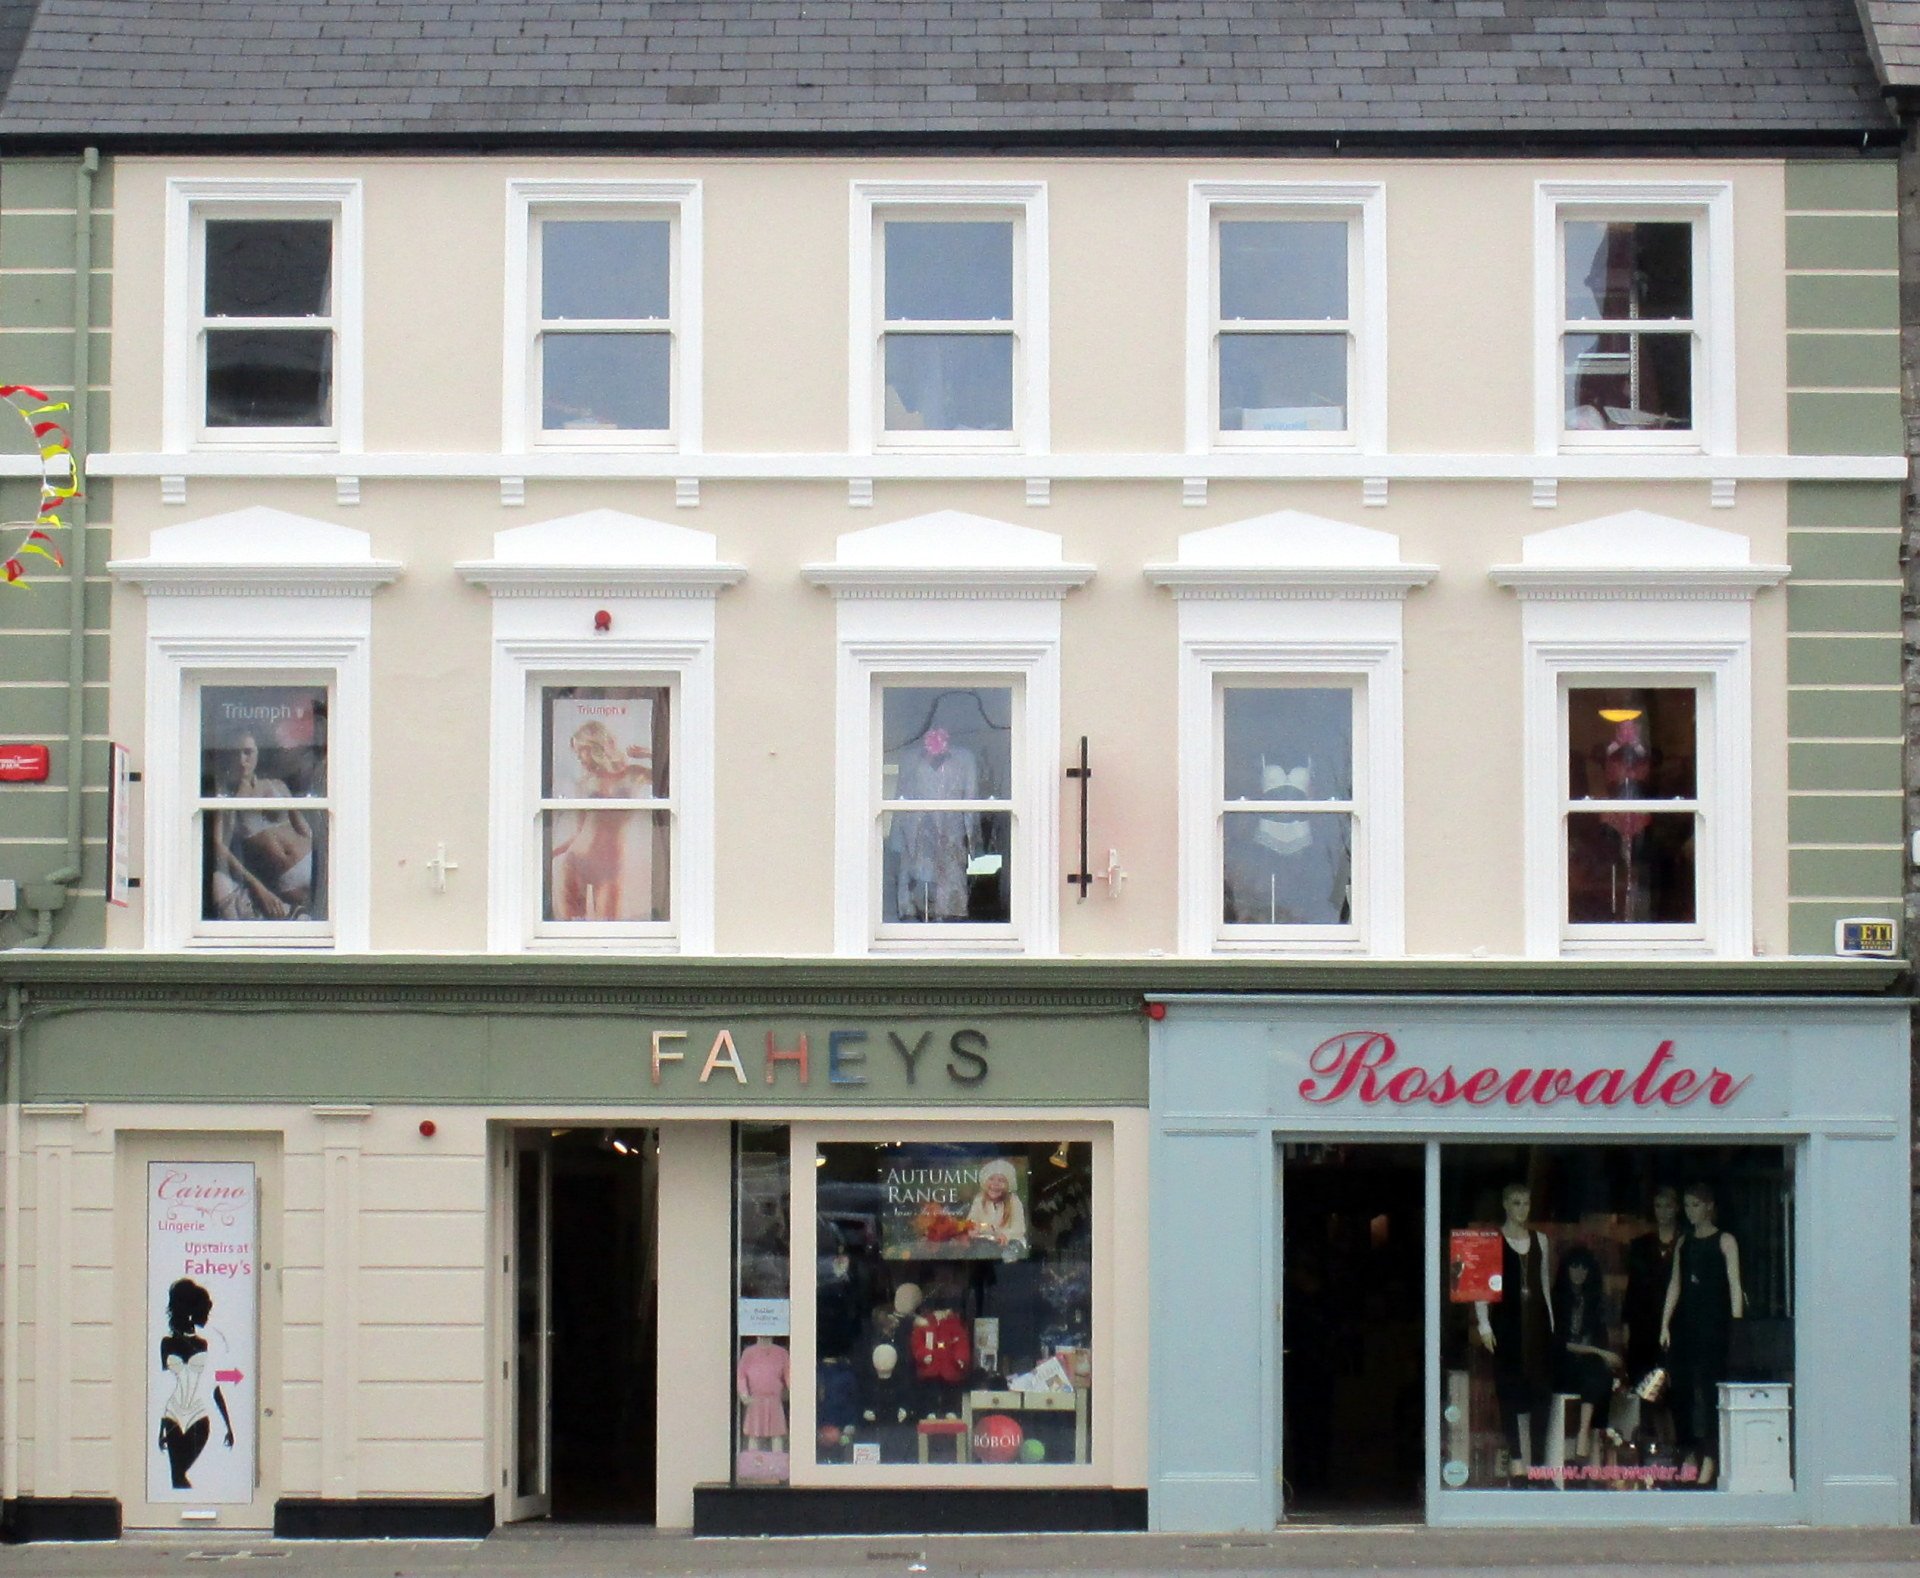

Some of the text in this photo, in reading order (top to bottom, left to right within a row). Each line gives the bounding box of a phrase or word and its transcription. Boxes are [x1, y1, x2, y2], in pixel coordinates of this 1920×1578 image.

[222, 703, 291, 722] Triumph
[577, 705, 619, 715] Triumph
[1860, 924, 1892, 940] ETI
[651, 1029, 989, 1086] FAHEYS
[1299, 1031, 1754, 1107] Rosewater
[887, 1168, 979, 1184] AUTUMN
[158, 1170, 246, 1200] Carino
[888, 1186, 958, 1203] RANGE
[158, 1221, 205, 1233] Lingerie
[185, 1242, 249, 1255] Upstairs at
[184, 1259, 251, 1278] Fahey's
